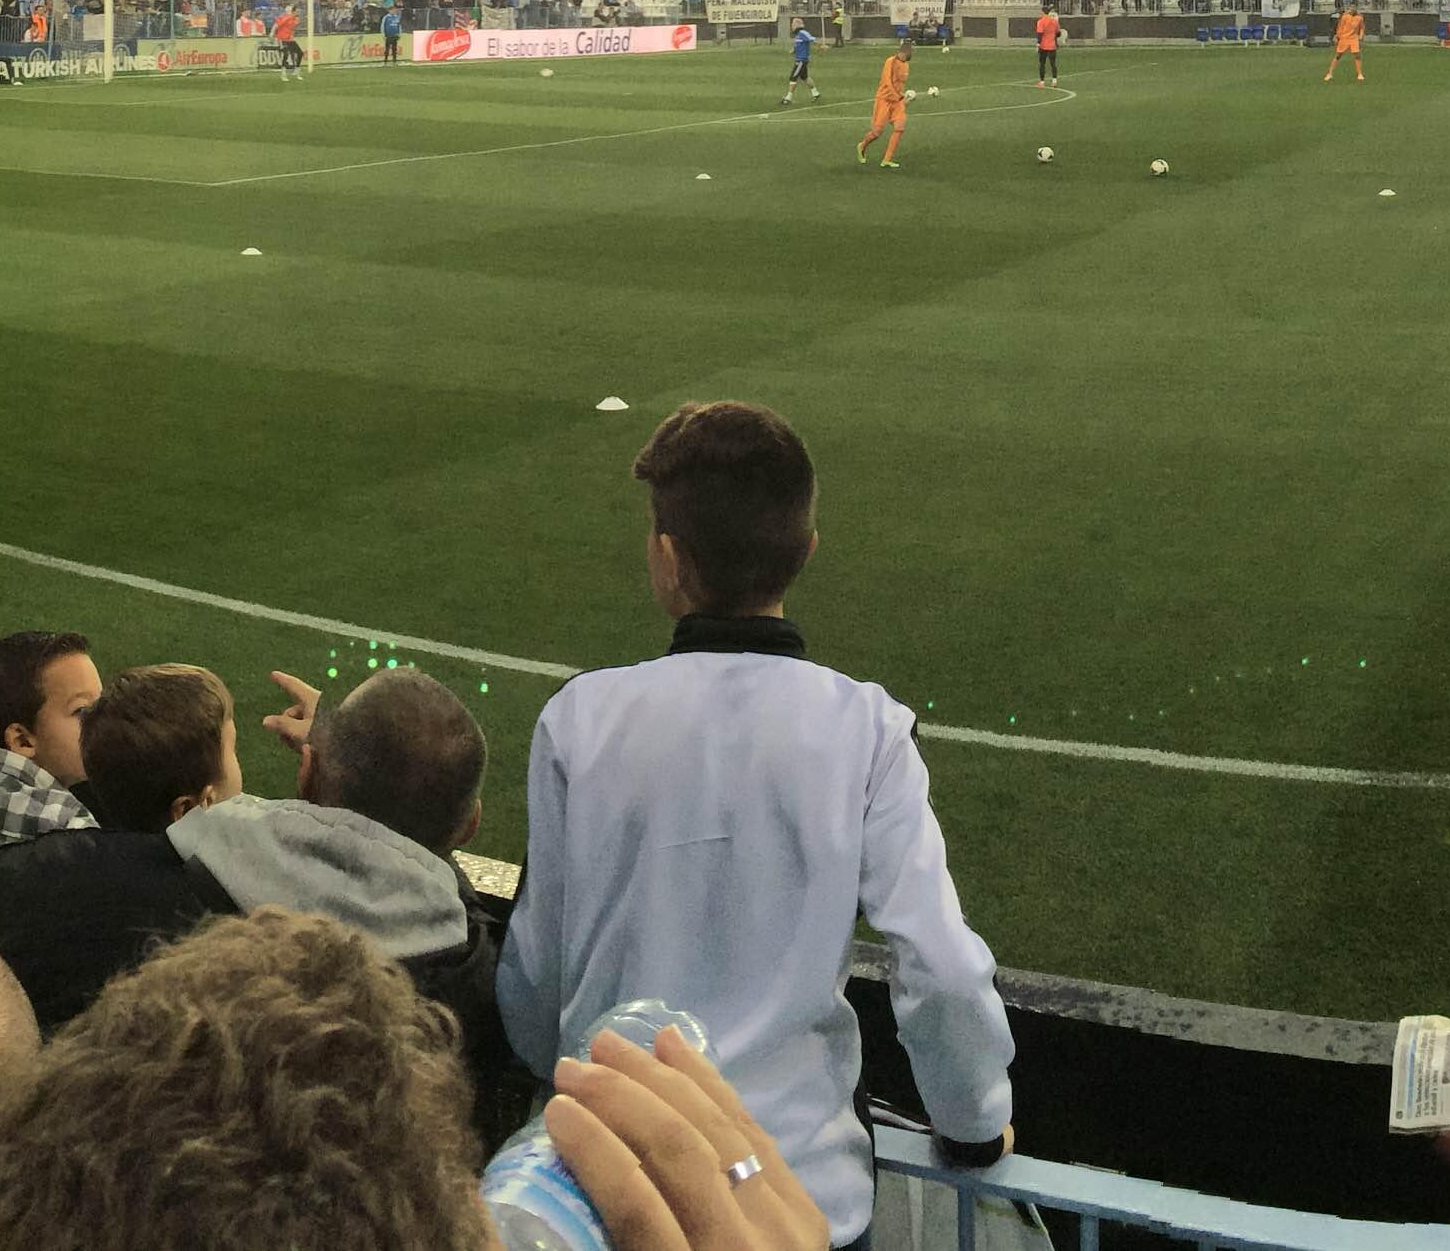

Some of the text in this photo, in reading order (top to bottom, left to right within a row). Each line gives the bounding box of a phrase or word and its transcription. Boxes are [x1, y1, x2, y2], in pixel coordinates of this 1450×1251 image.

[487, 28, 632, 57] El sabor de la Calidad
[11, 59, 81, 78] TURKISH
